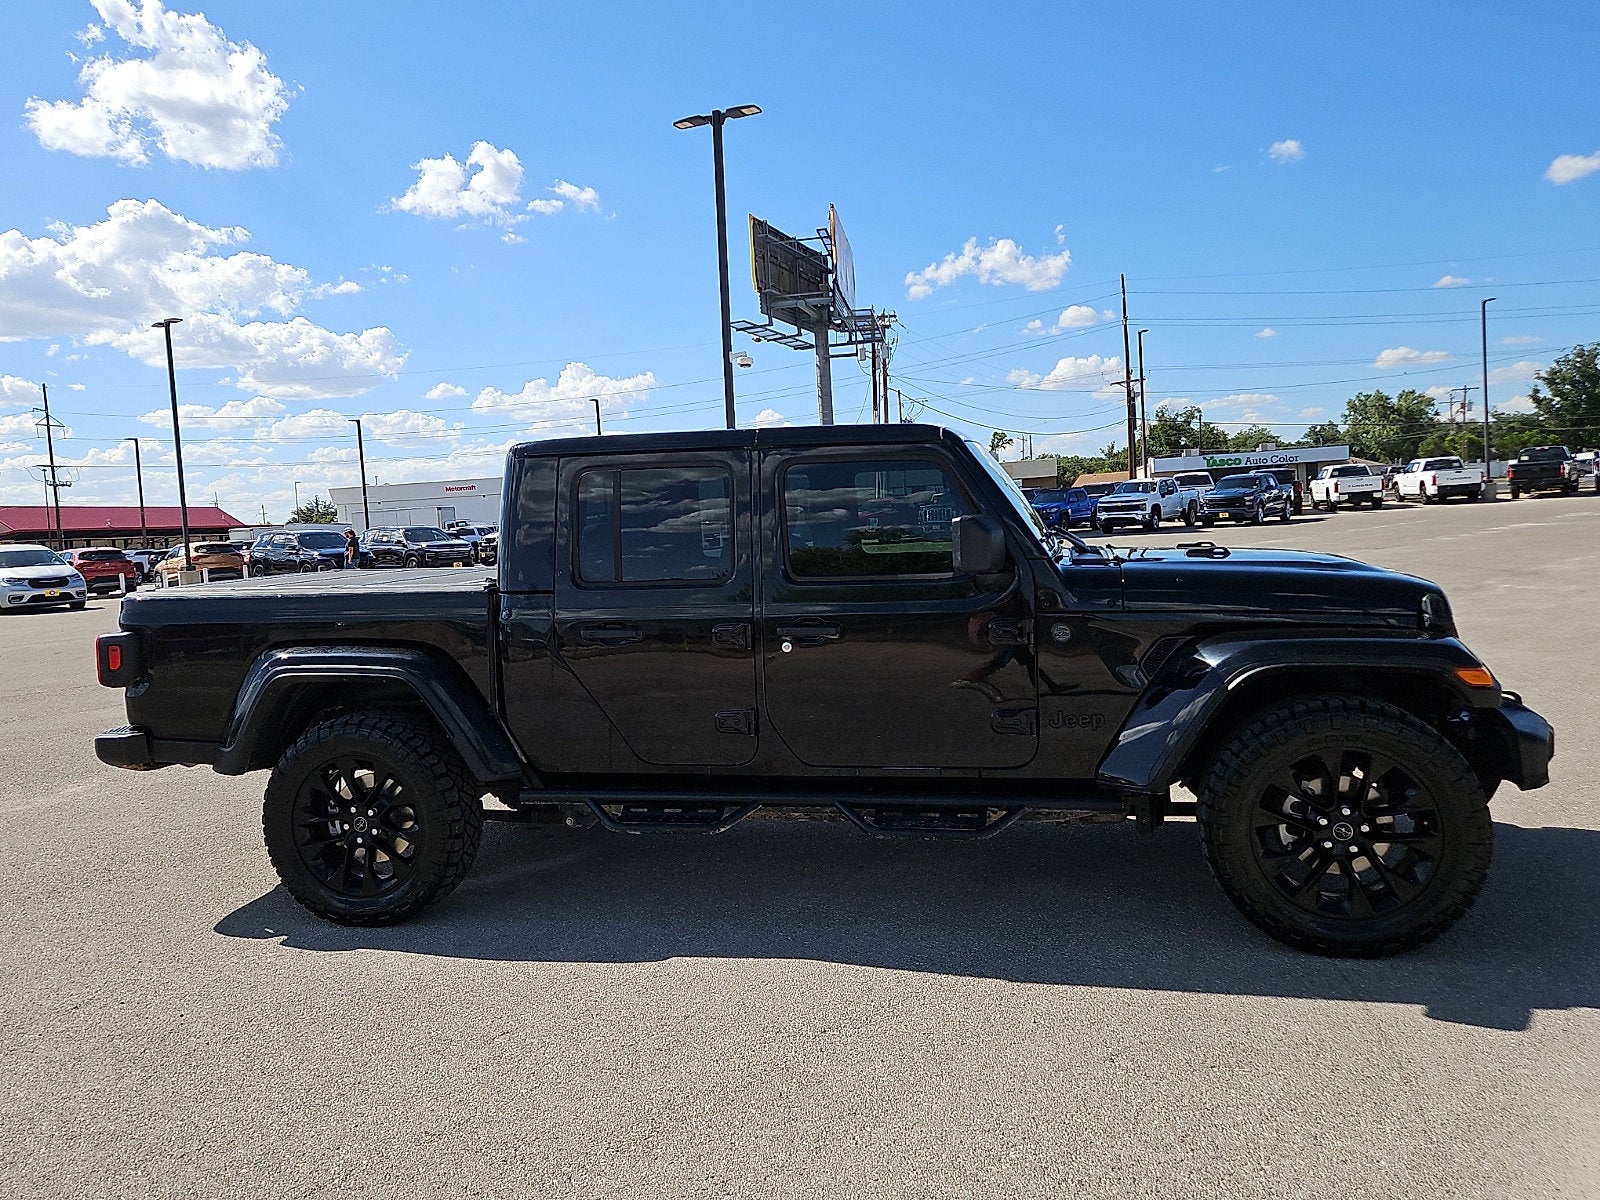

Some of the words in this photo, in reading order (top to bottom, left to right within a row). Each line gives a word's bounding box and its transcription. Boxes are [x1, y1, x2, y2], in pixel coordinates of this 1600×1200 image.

[1245, 456, 1268, 466] Auto
[1270, 455, 1300, 464] Color
[445, 484, 477, 493] Motorcraft
[1049, 710, 1105, 731] Jeep
